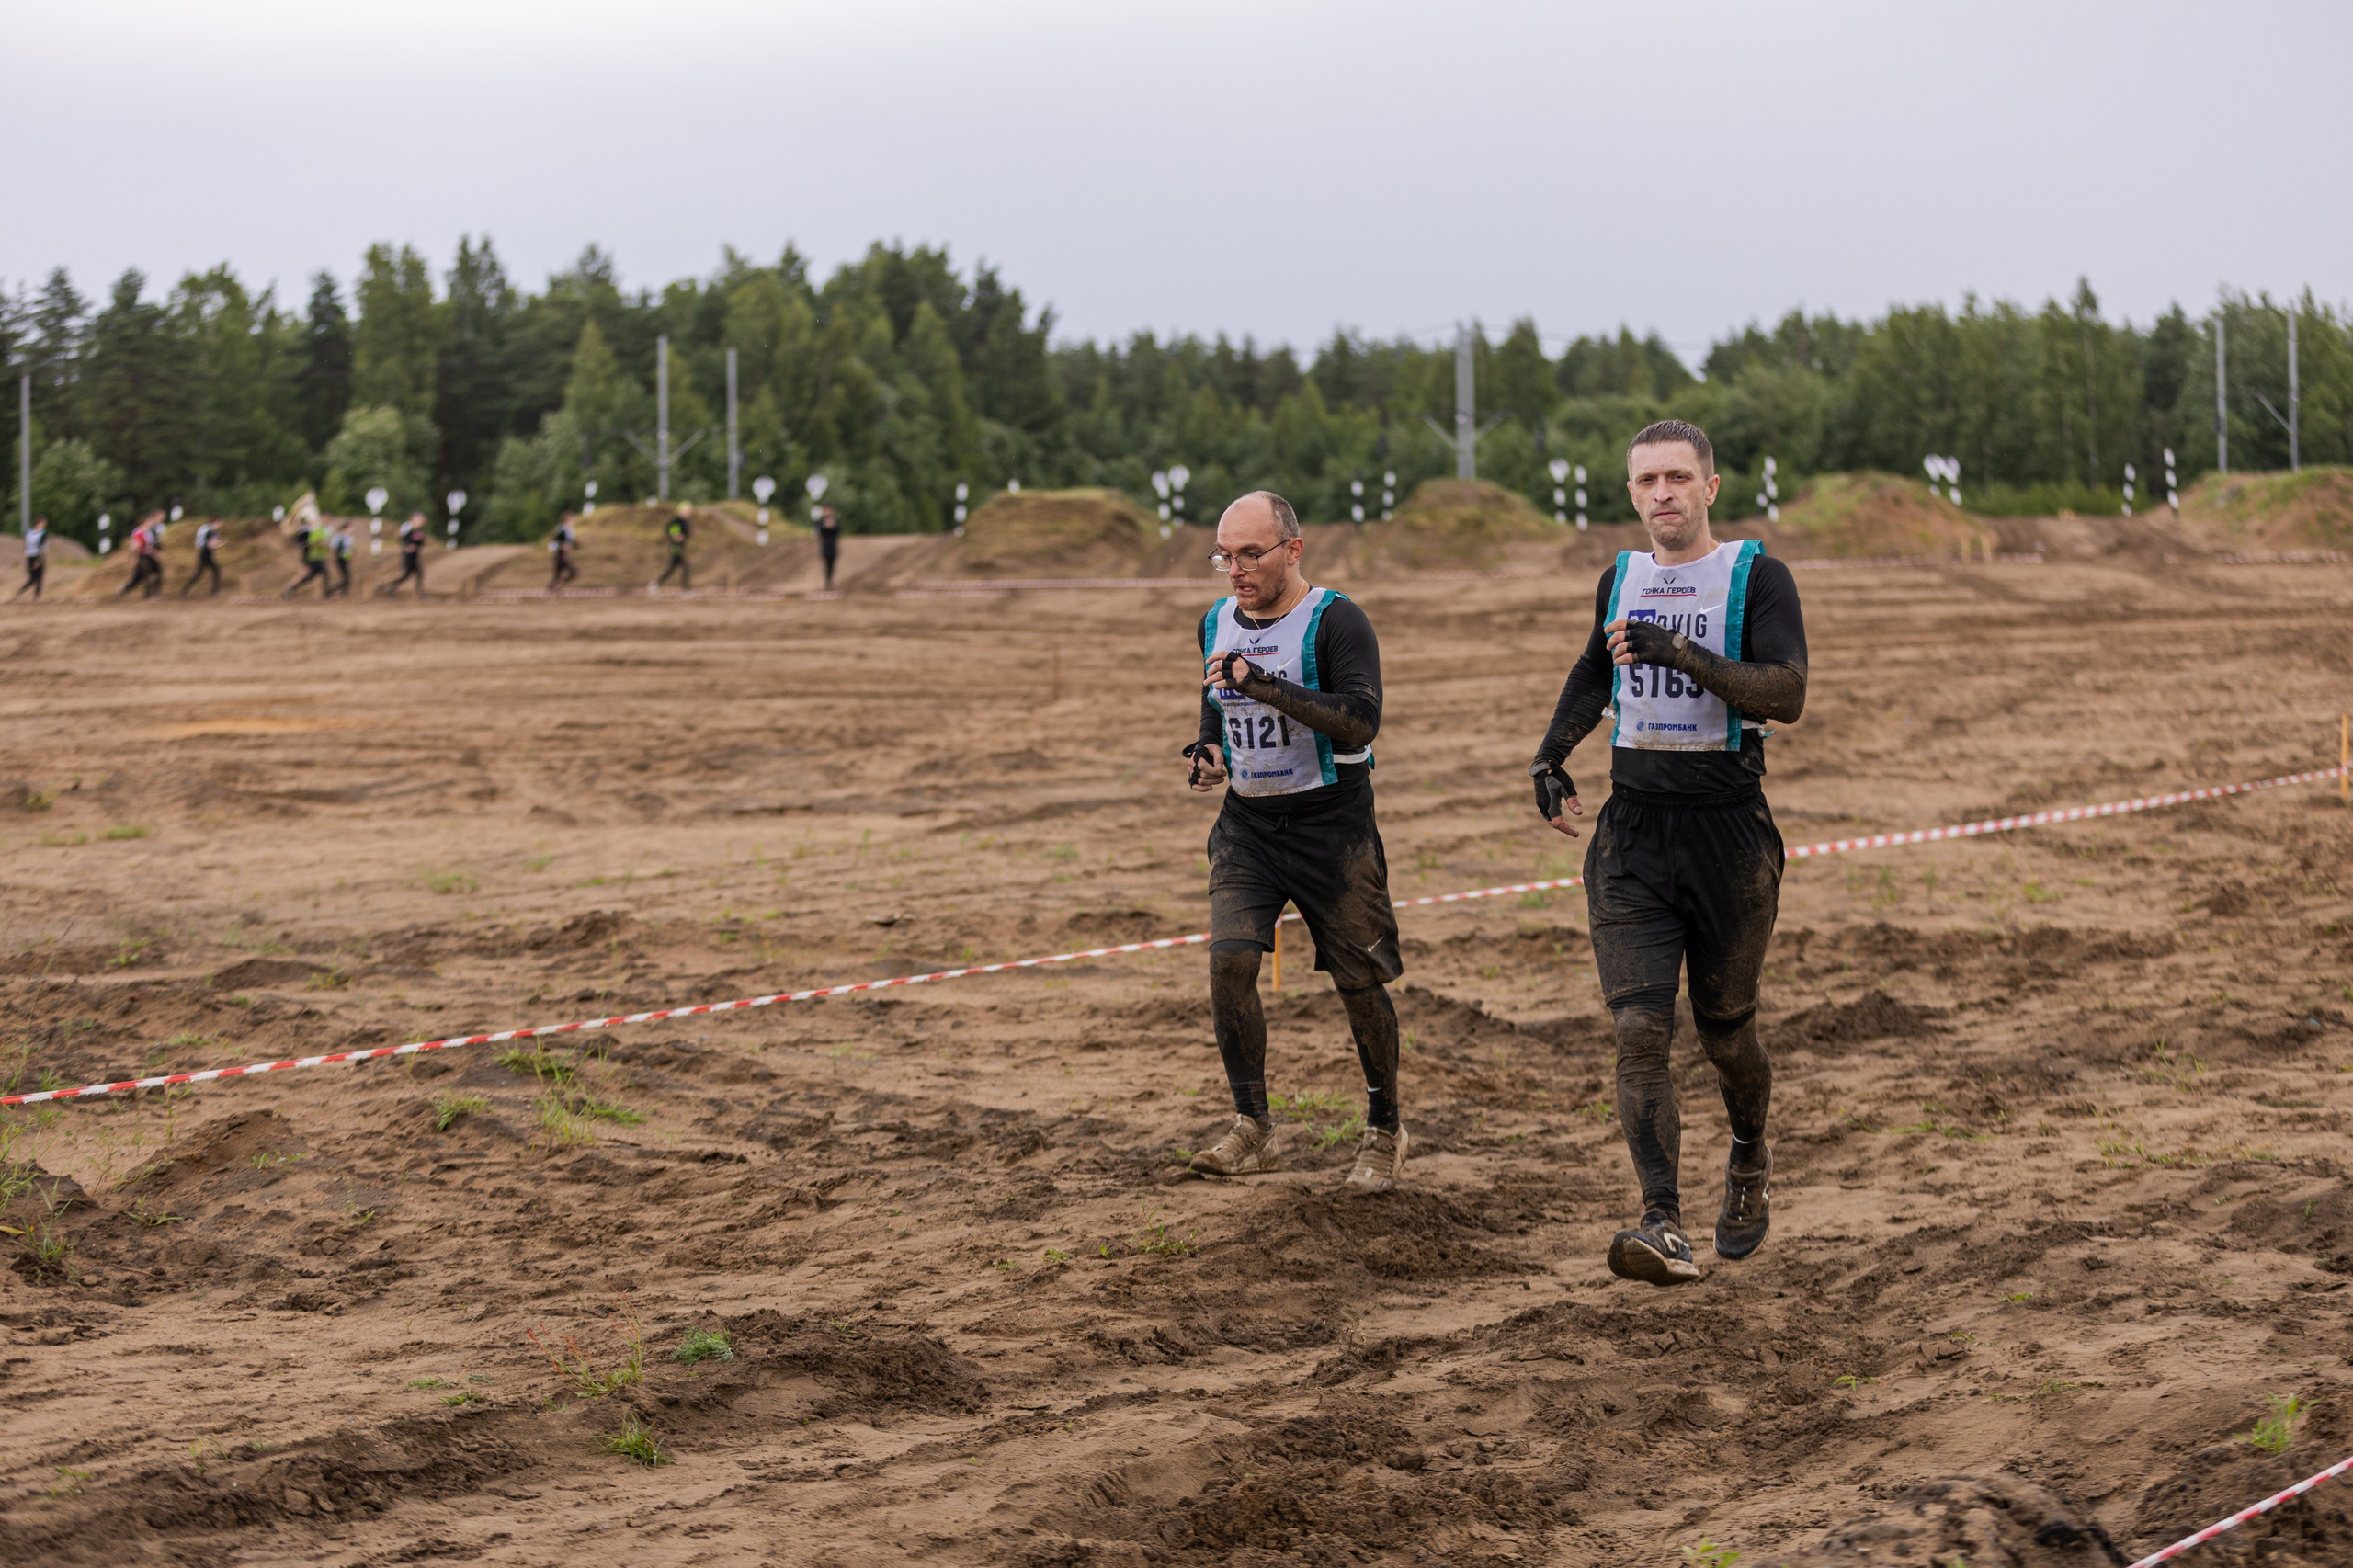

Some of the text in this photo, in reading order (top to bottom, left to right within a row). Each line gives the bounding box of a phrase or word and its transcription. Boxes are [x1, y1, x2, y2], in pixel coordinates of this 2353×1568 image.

[1253, 645, 1279, 653] ГЕРОЕВ
[1229, 714, 1290, 749] 6121
[1648, 722, 1698, 732] ГАЗПРОМБАНК
[1251, 768, 1294, 778] ГАЗПРОМБАНК
